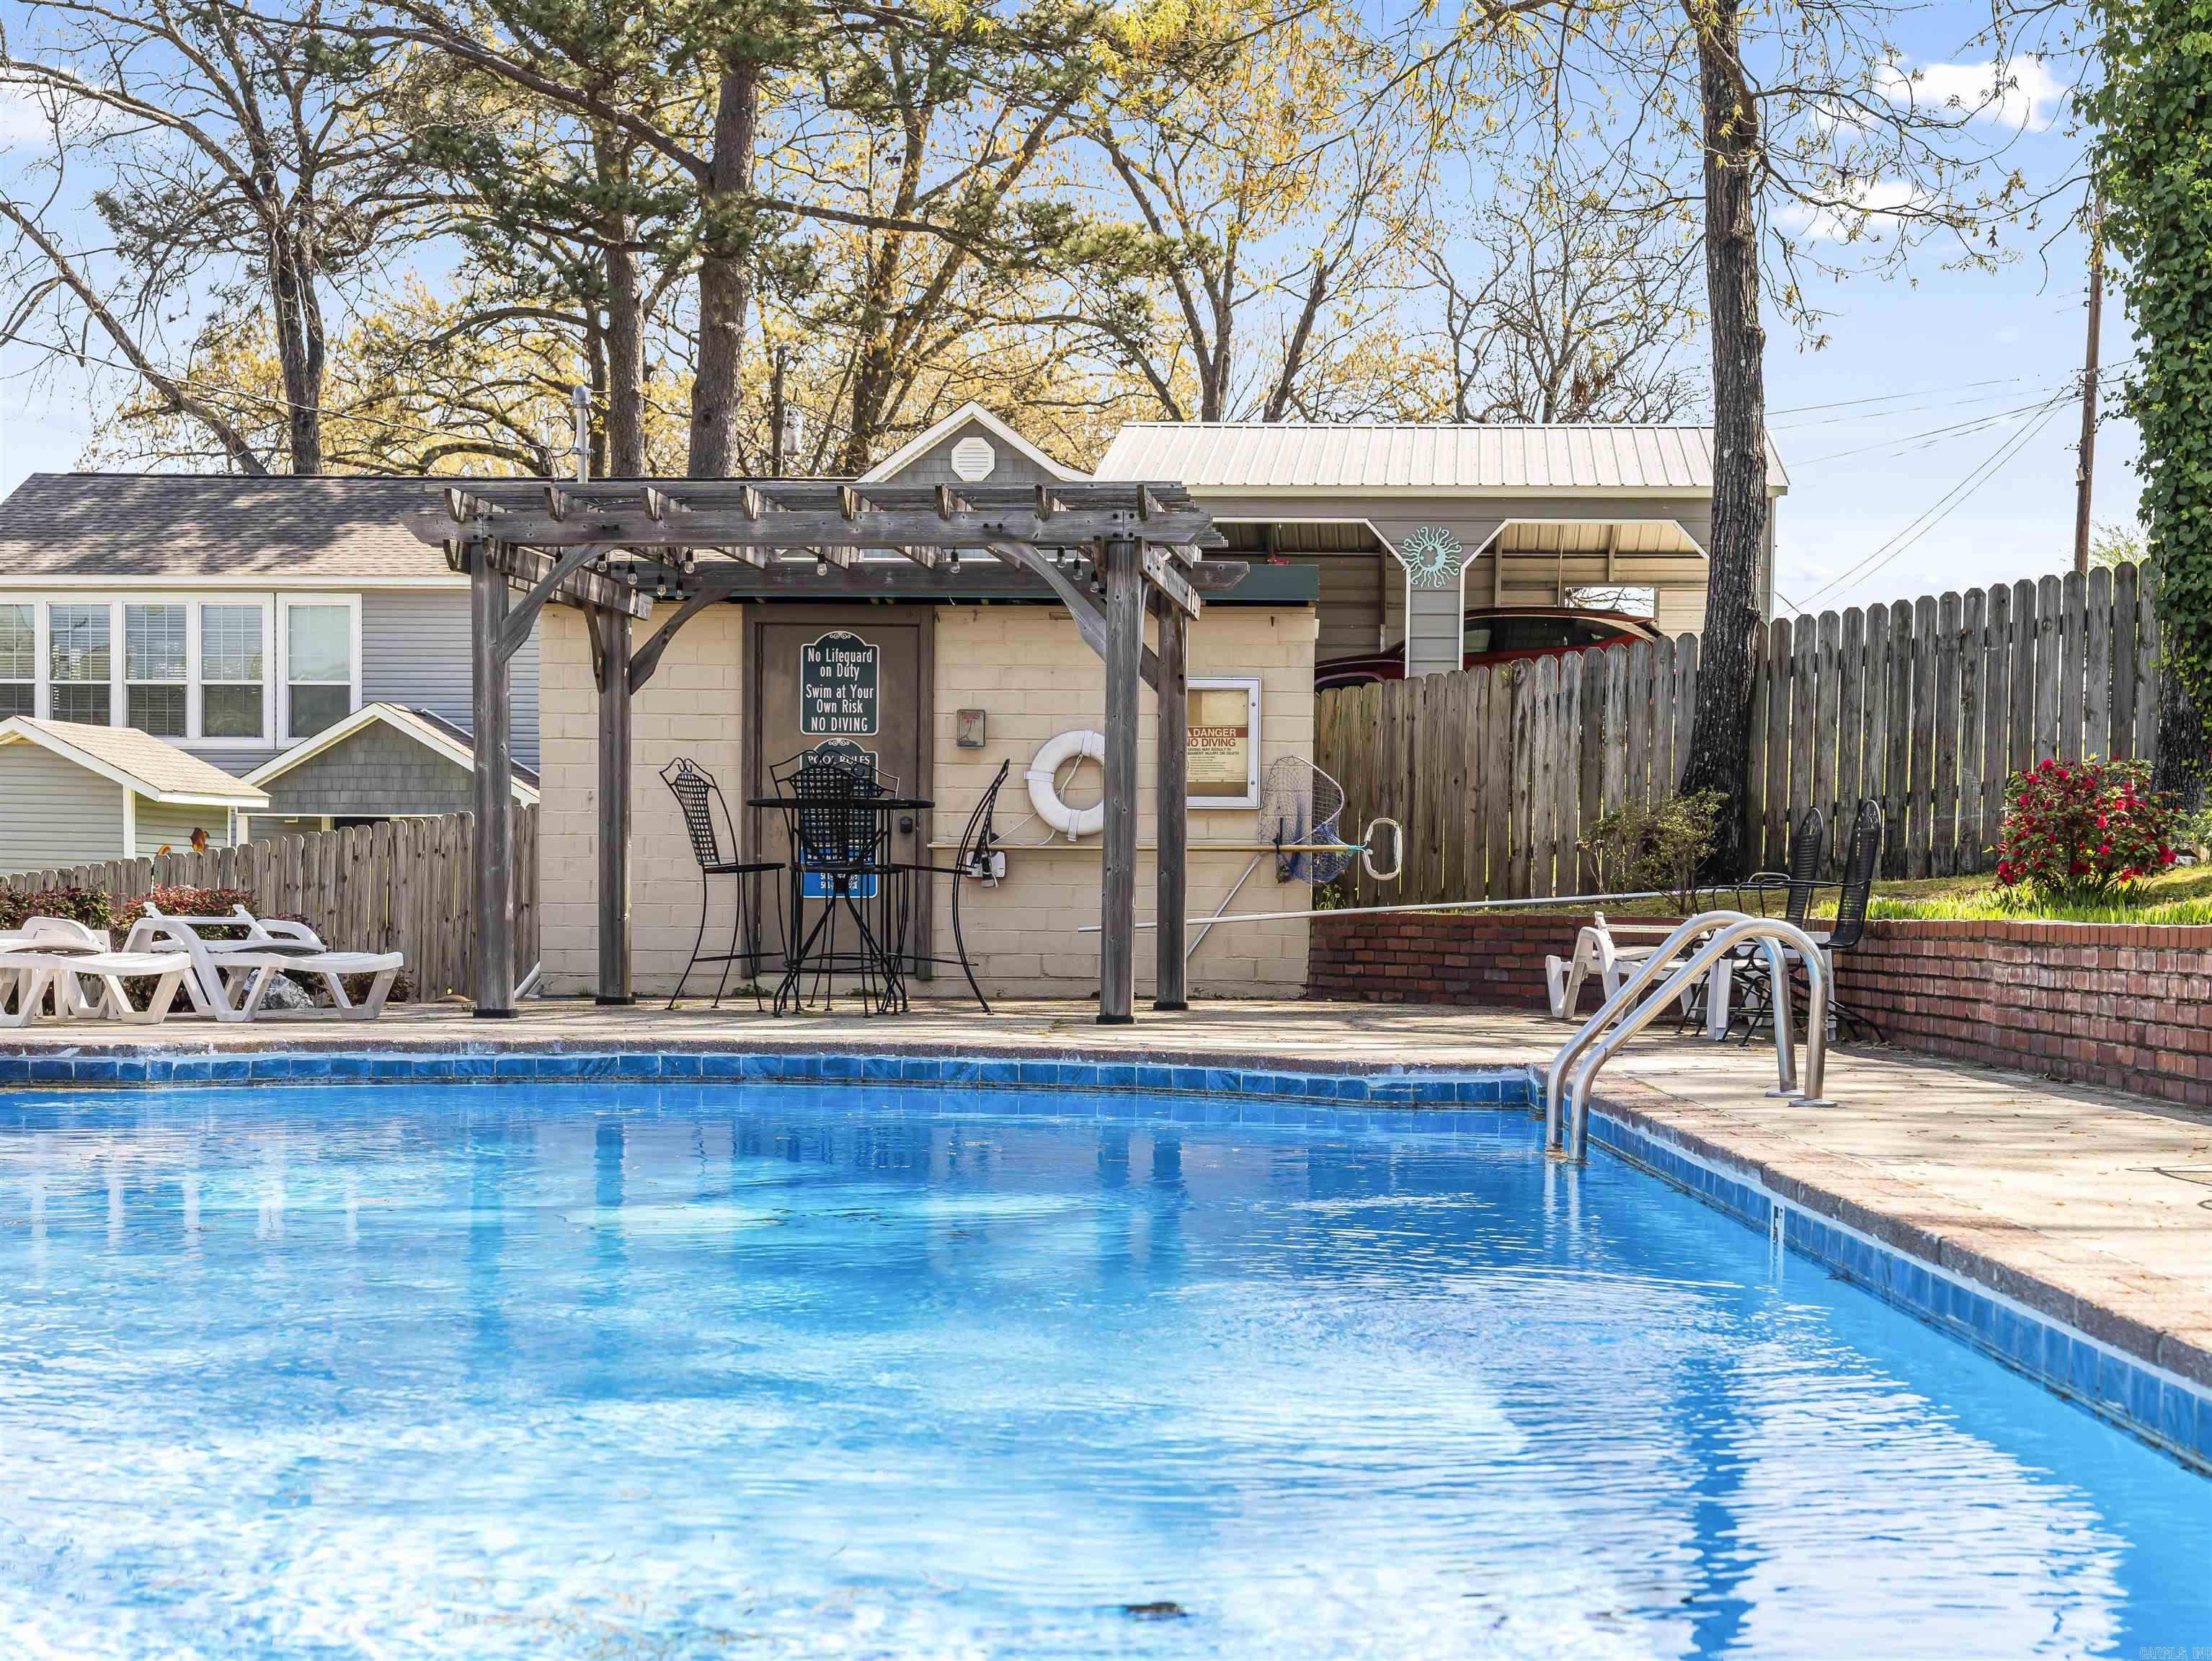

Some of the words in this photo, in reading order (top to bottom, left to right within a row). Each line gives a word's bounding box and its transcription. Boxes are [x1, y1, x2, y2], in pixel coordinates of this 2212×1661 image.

[807, 647, 821, 662] No
[826, 647, 872, 666] Lifeguard
[820, 666, 832, 677] on
[837, 663, 860, 681] Duty
[806, 683, 832, 698] Swim
[836, 684, 846, 699] at
[850, 684, 874, 699] Your
[817, 699, 837, 713] Own
[842, 699, 863, 713] Risk
[811, 717, 826, 731] NO
[831, 717, 868, 731] DIVING
[1193, 728, 1237, 737] DANGER
[1202, 738, 1236, 747] DIVING
